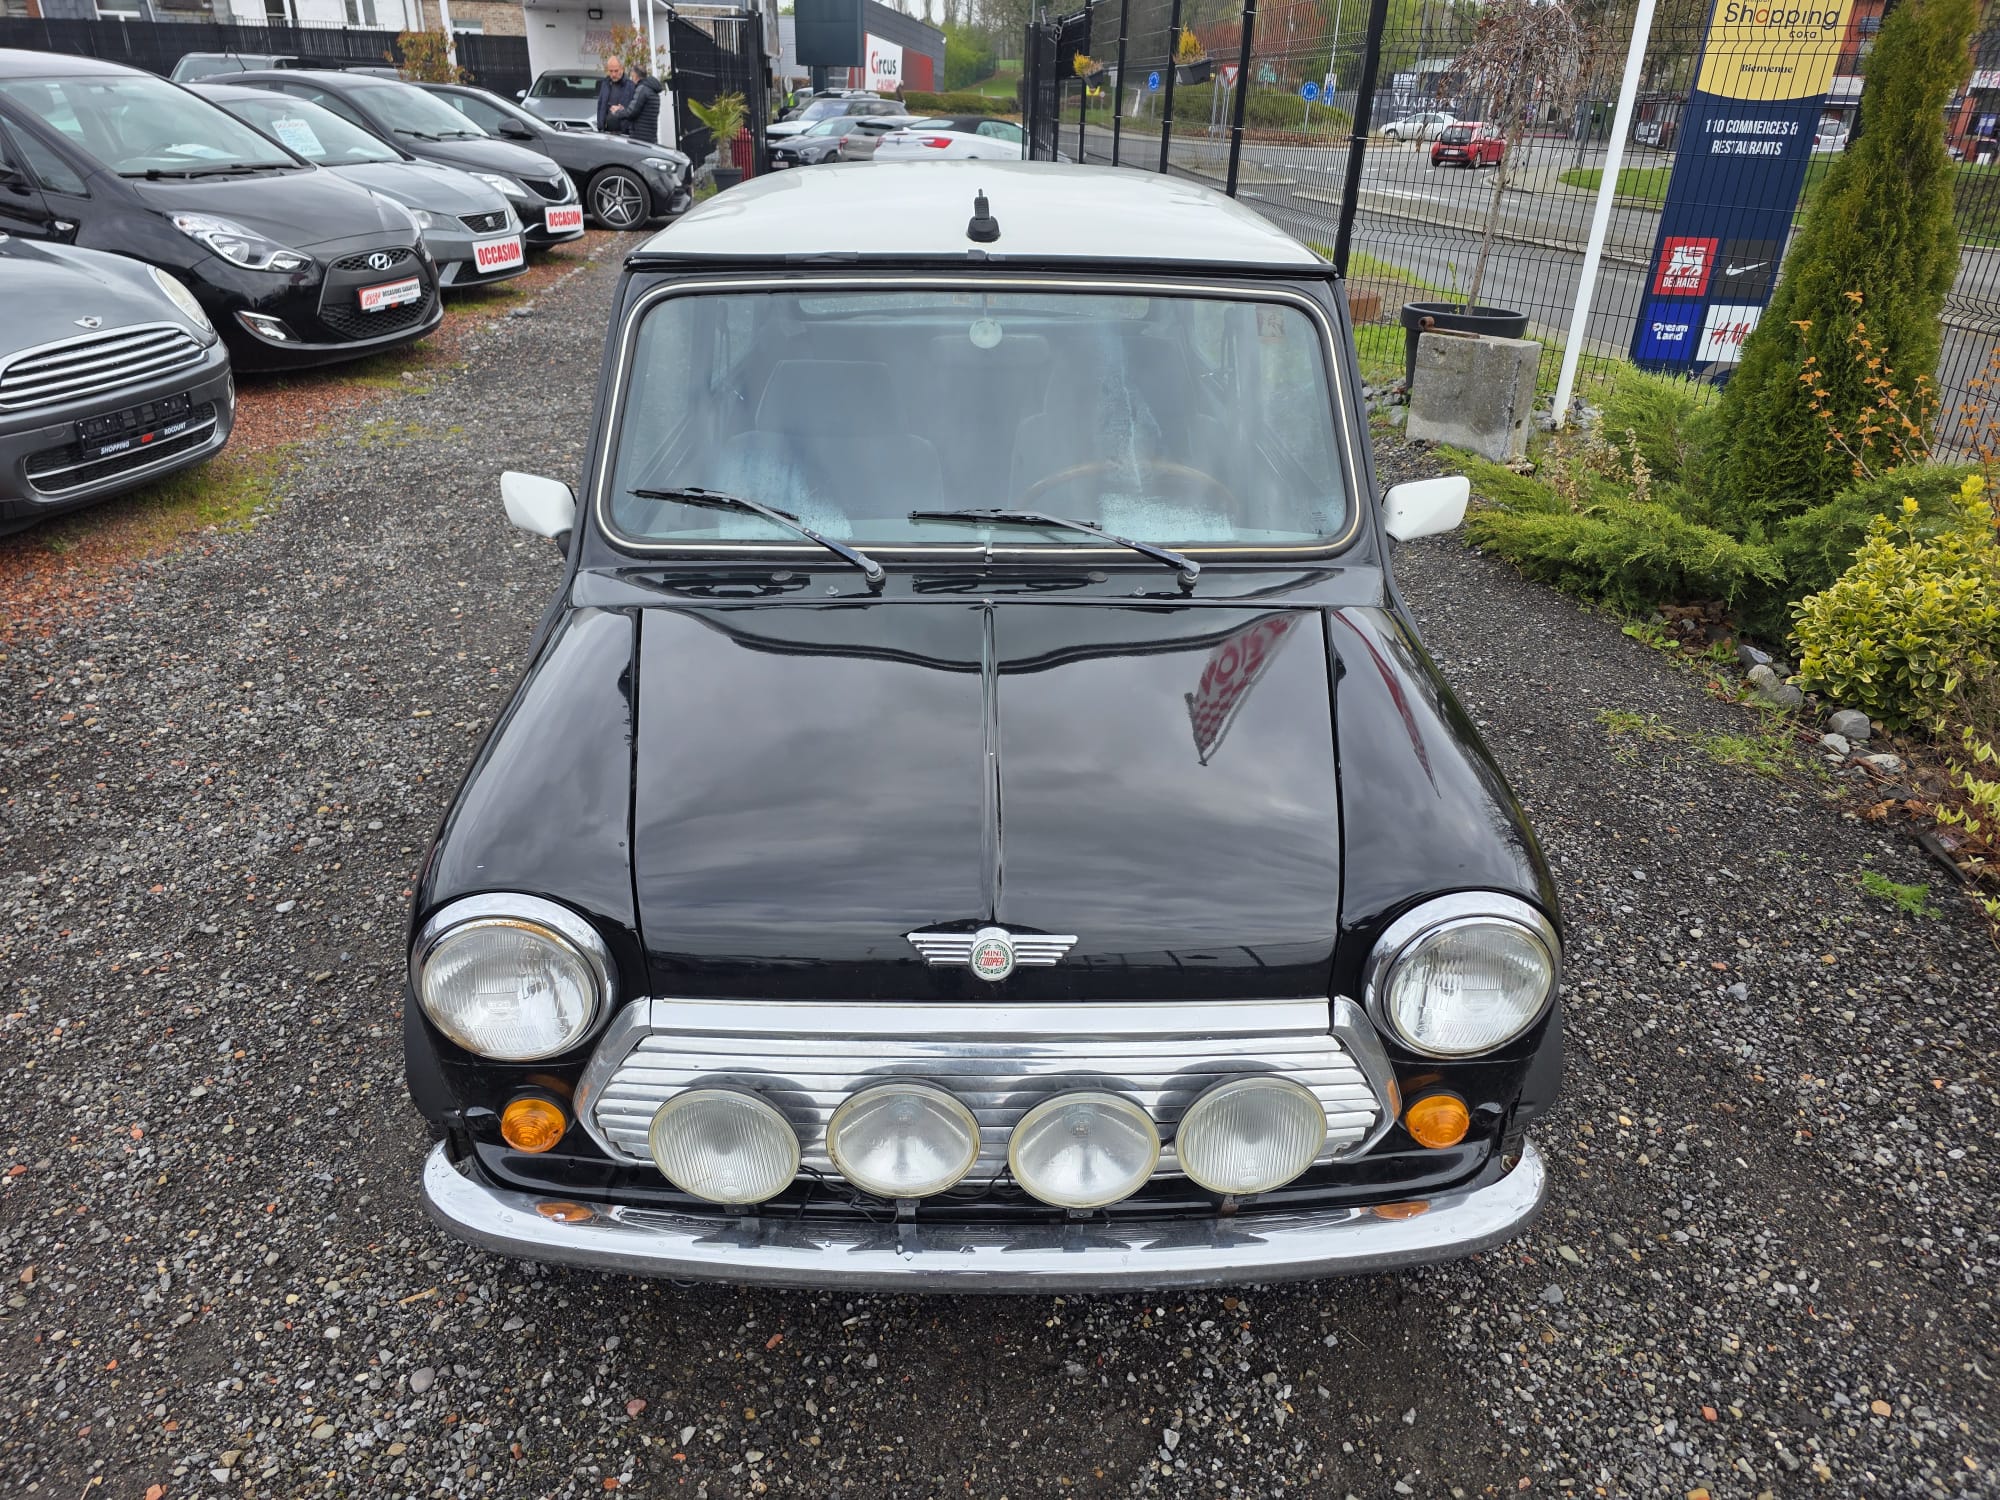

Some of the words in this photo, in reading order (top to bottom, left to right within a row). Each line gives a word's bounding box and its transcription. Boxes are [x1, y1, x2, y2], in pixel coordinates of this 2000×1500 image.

[1724, 2, 1839, 30] Shopping
[1789, 30, 1817, 39] cora
[871, 50, 897, 75] Circus
[1740, 63, 1794, 74] Bienvenue
[1711, 139, 1783, 156] RESTAURANTS
[548, 210, 582, 227] OCCASION
[477, 241, 521, 266] OCCASION
[100, 440, 130, 455] SHOPPING
[979, 957, 1006, 967] COOPER
